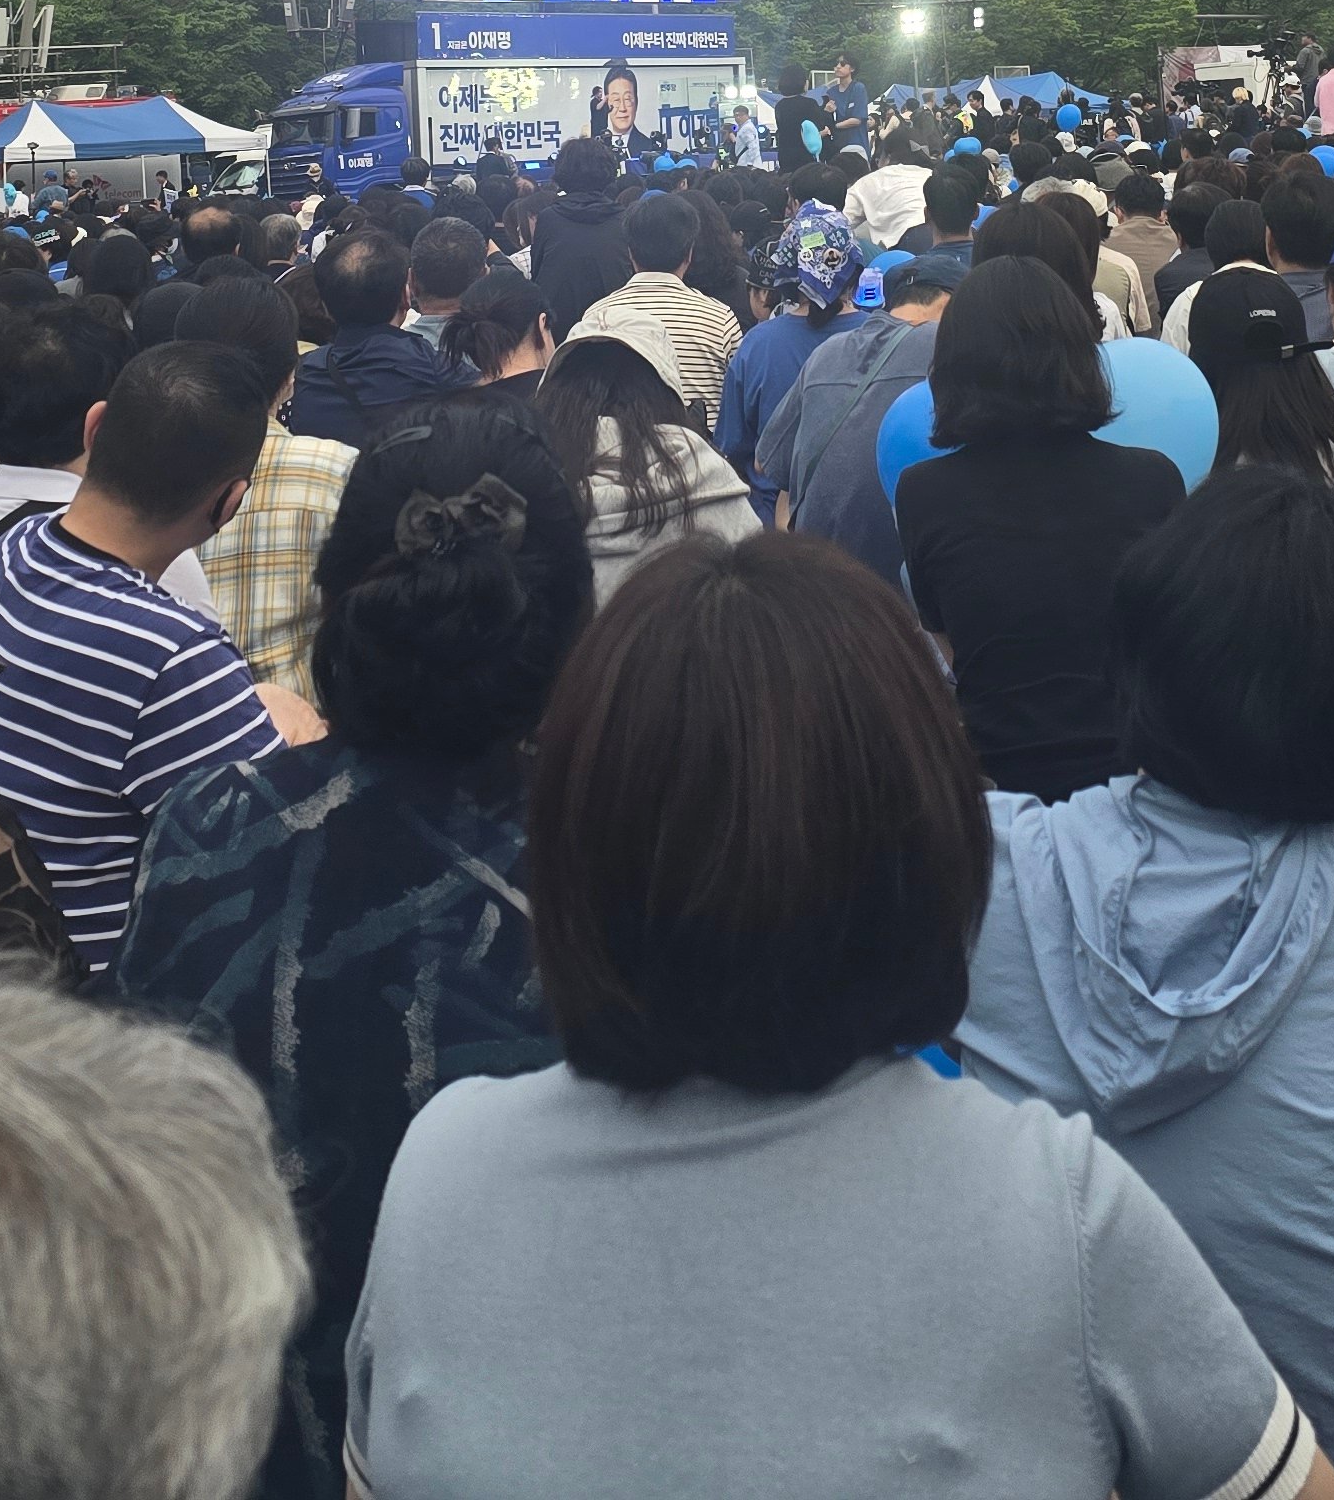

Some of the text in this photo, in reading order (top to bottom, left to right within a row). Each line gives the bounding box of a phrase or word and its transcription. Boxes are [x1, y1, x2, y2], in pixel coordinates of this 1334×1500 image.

[431, 22, 441, 50] 1
[468, 31, 512, 50] 이재명
[622, 31, 729, 49] 이제부터 진짜 대한민국
[439, 122, 481, 152] 진짜
[338, 154, 374, 170] 1 이재명
[105, 190, 142, 199] telecom
